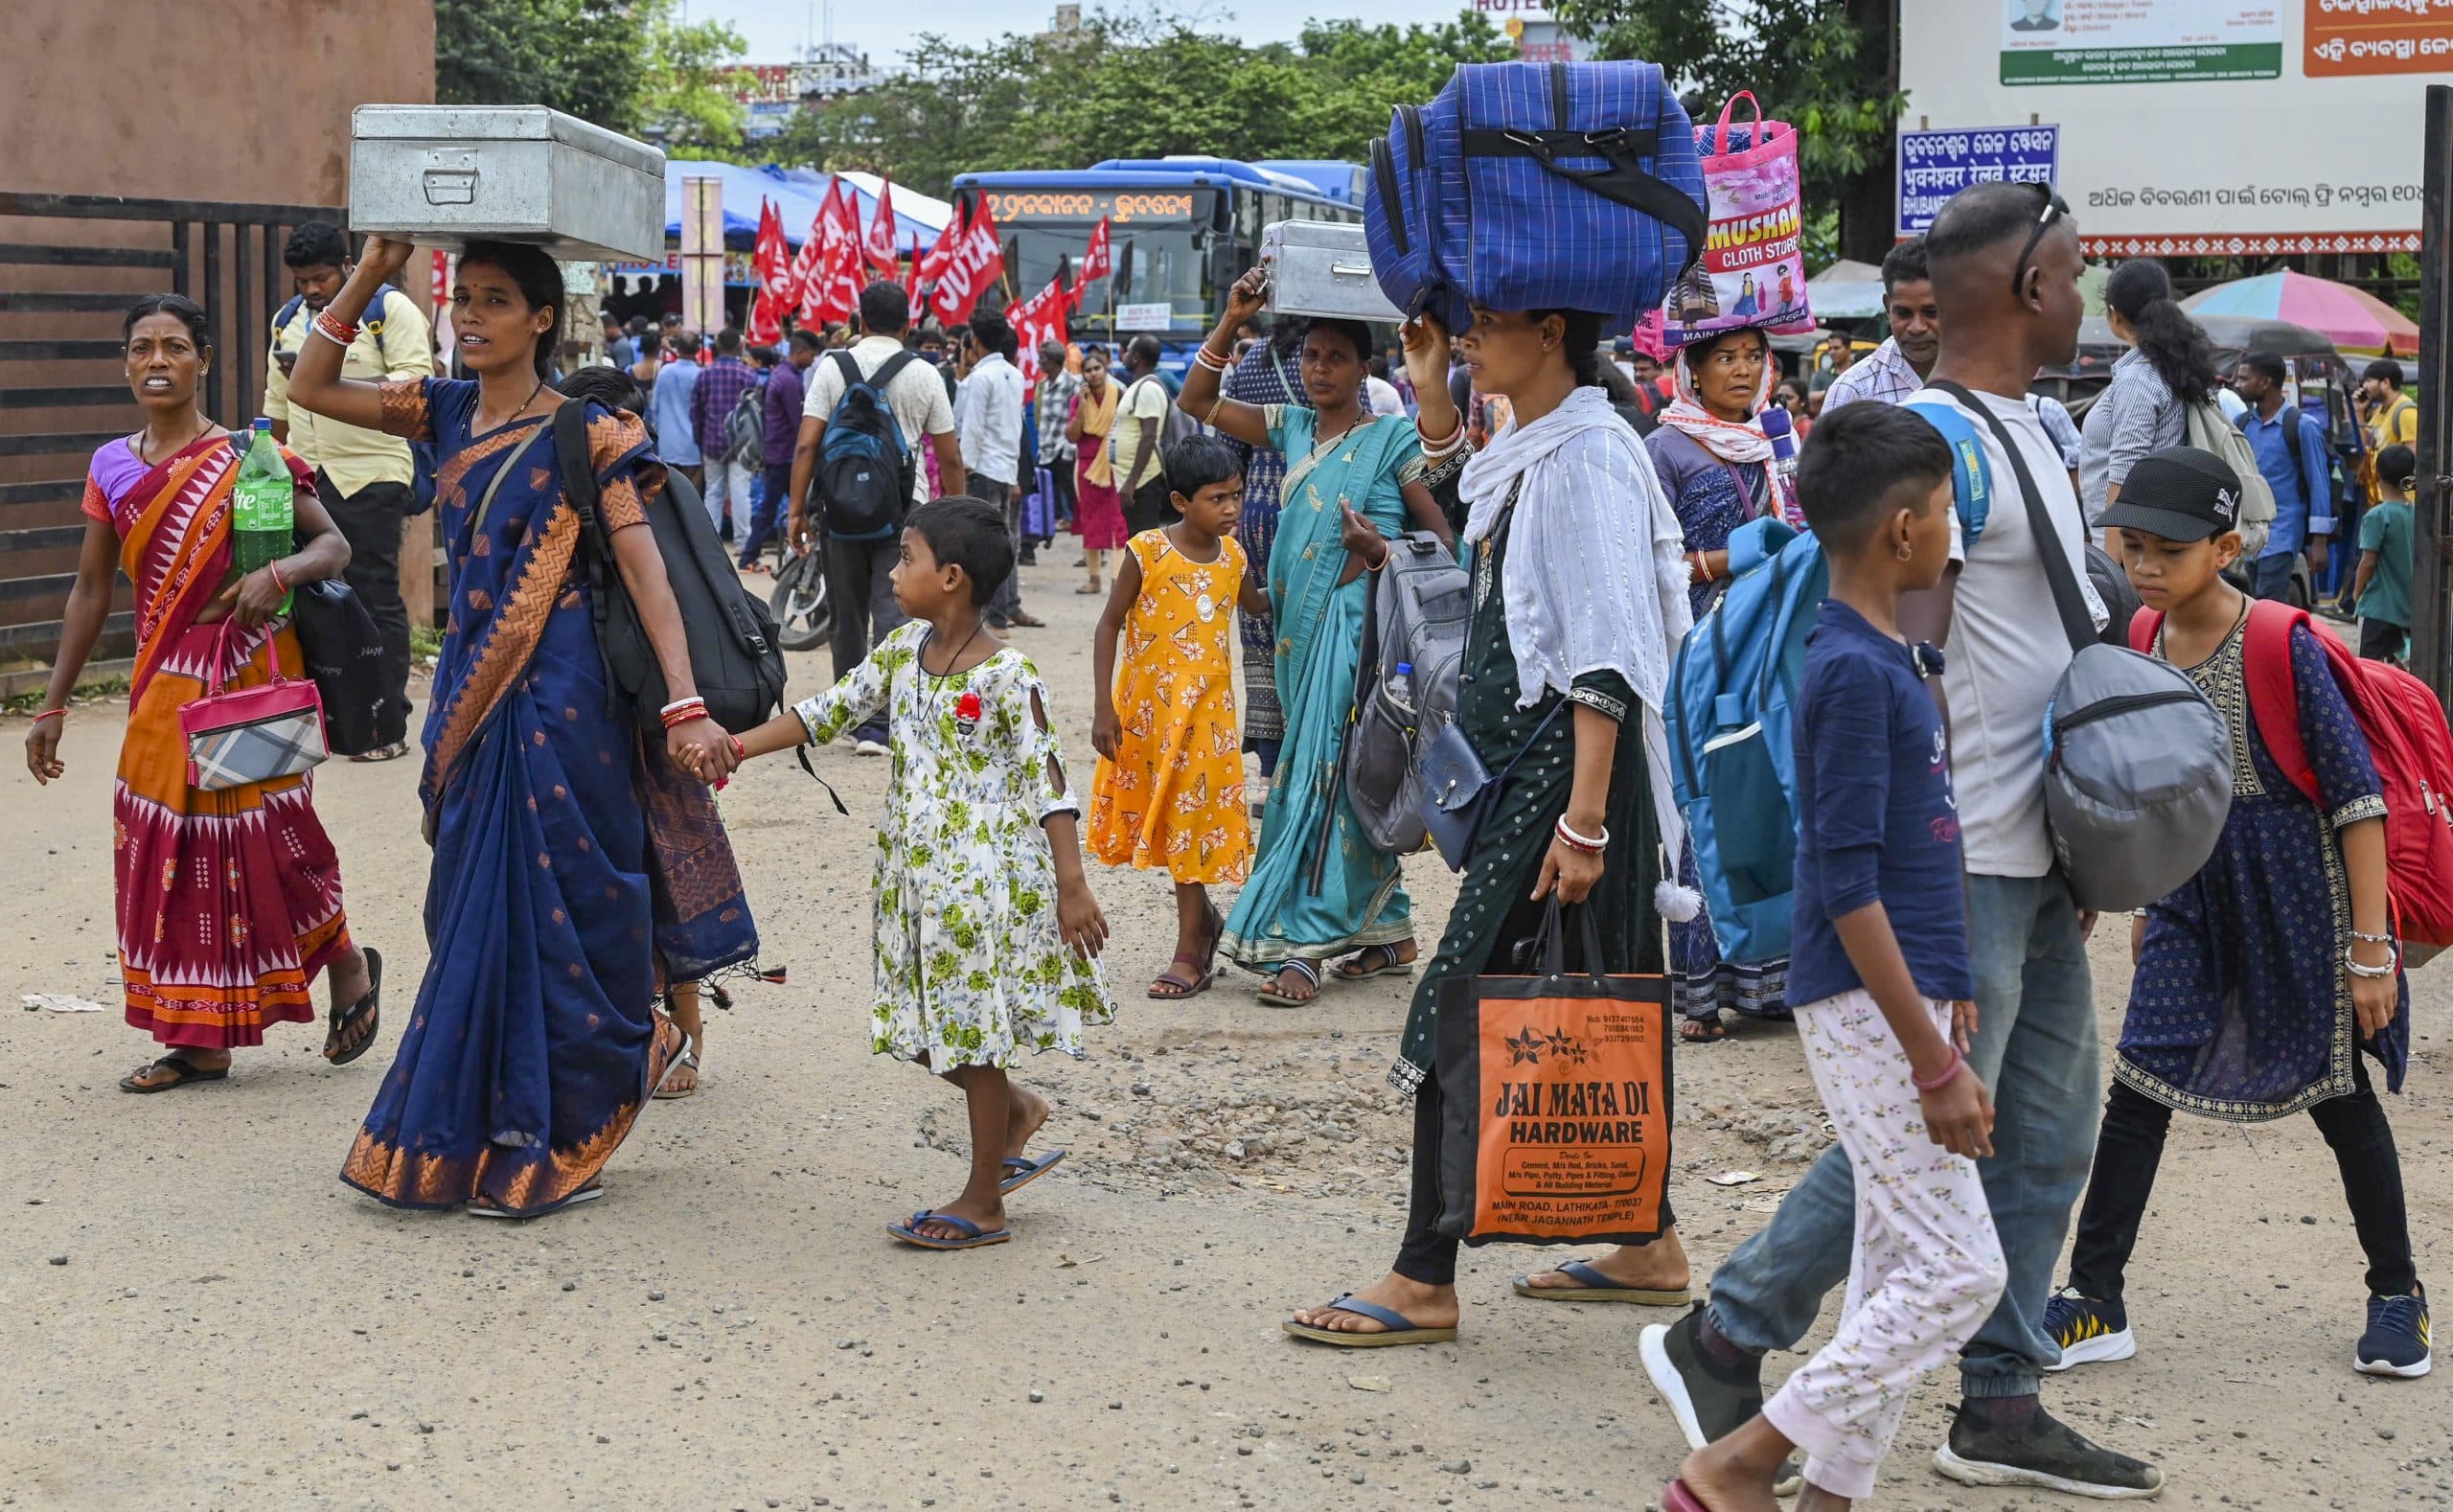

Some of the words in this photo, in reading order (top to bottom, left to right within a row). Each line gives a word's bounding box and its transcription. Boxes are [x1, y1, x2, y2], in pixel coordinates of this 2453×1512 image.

[2088, 187, 2135, 207] ଅଧିକ
[2140, 186, 2211, 206] ବିବରଣୀ
[1708, 202, 1799, 251] MUSKAN
[1722, 245, 1762, 267] CLOTH
[1495, 1082, 1543, 1117] JAI
[1547, 1081, 1620, 1117] MATA
[1623, 1081, 1650, 1116] DI
[1510, 1121, 1643, 1144] HARDWARE
[1555, 1181, 1583, 1190] Building
[1492, 1201, 1516, 1210] MAIN
[1519, 1201, 1552, 1213] ROAD,
[1497, 1212, 1528, 1223] (NEAR
[1531, 1215, 1593, 1226] JAGANNATH
[1597, 1211, 1635, 1224] TEMPLE)
